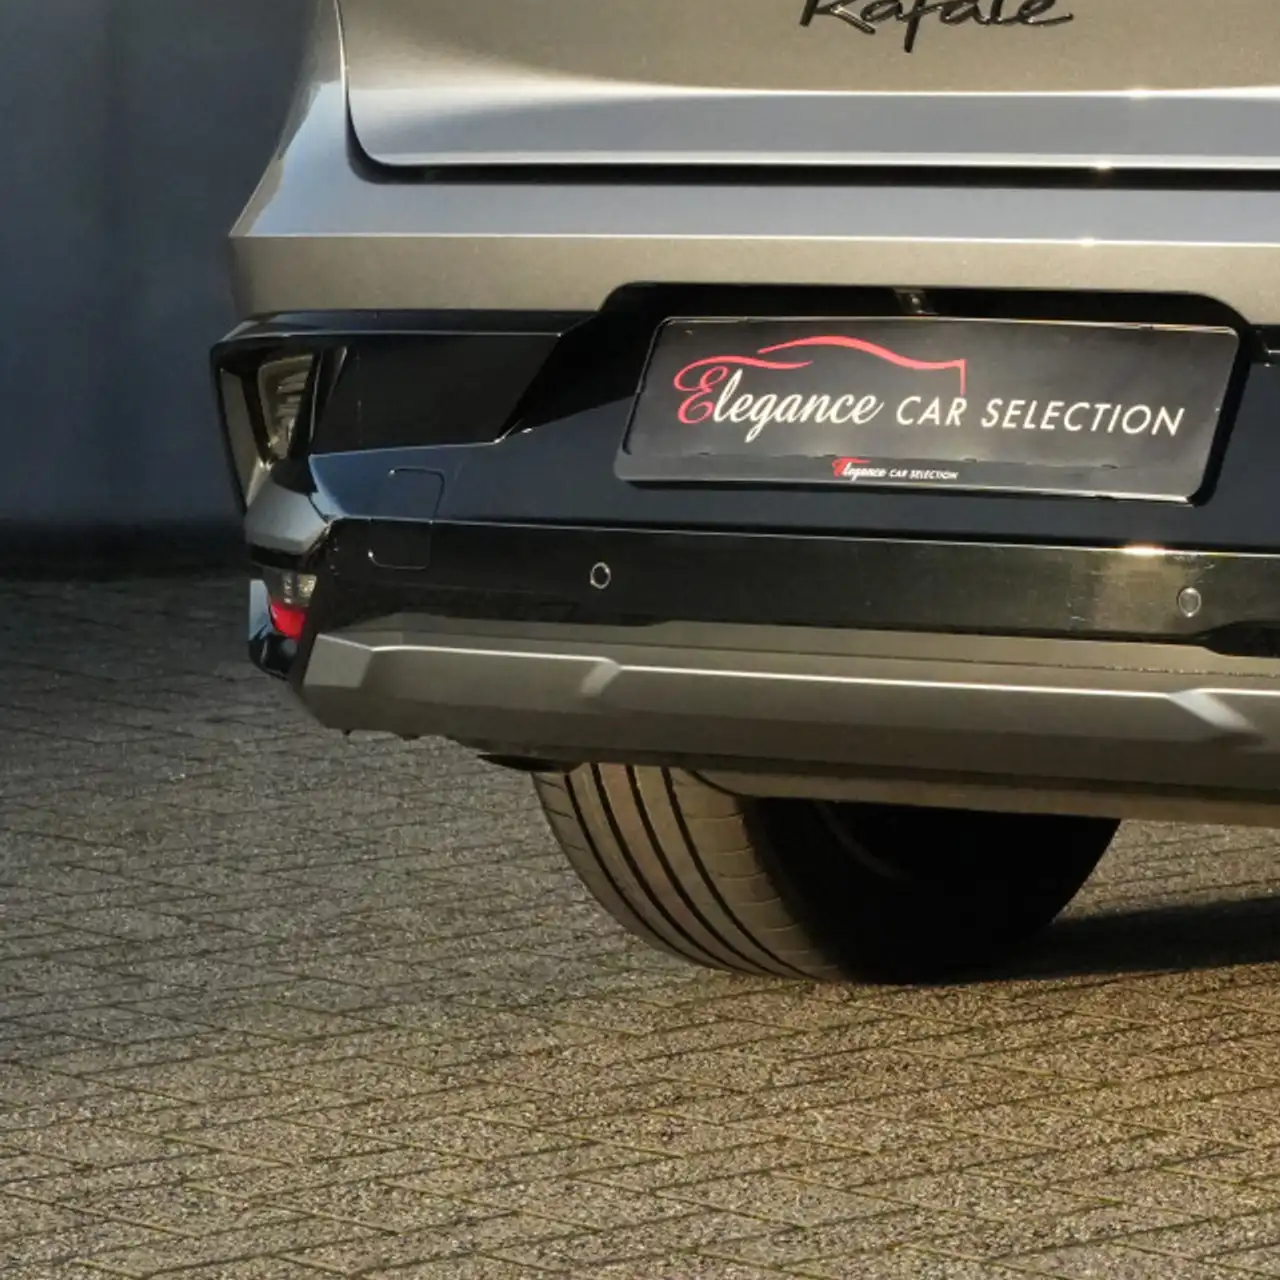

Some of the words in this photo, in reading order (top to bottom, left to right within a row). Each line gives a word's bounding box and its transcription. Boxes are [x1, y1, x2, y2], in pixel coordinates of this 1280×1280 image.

[673, 357, 884, 443] Elegance
[895, 395, 967, 426] CAR
[980, 398, 1185, 437] SELECTION
